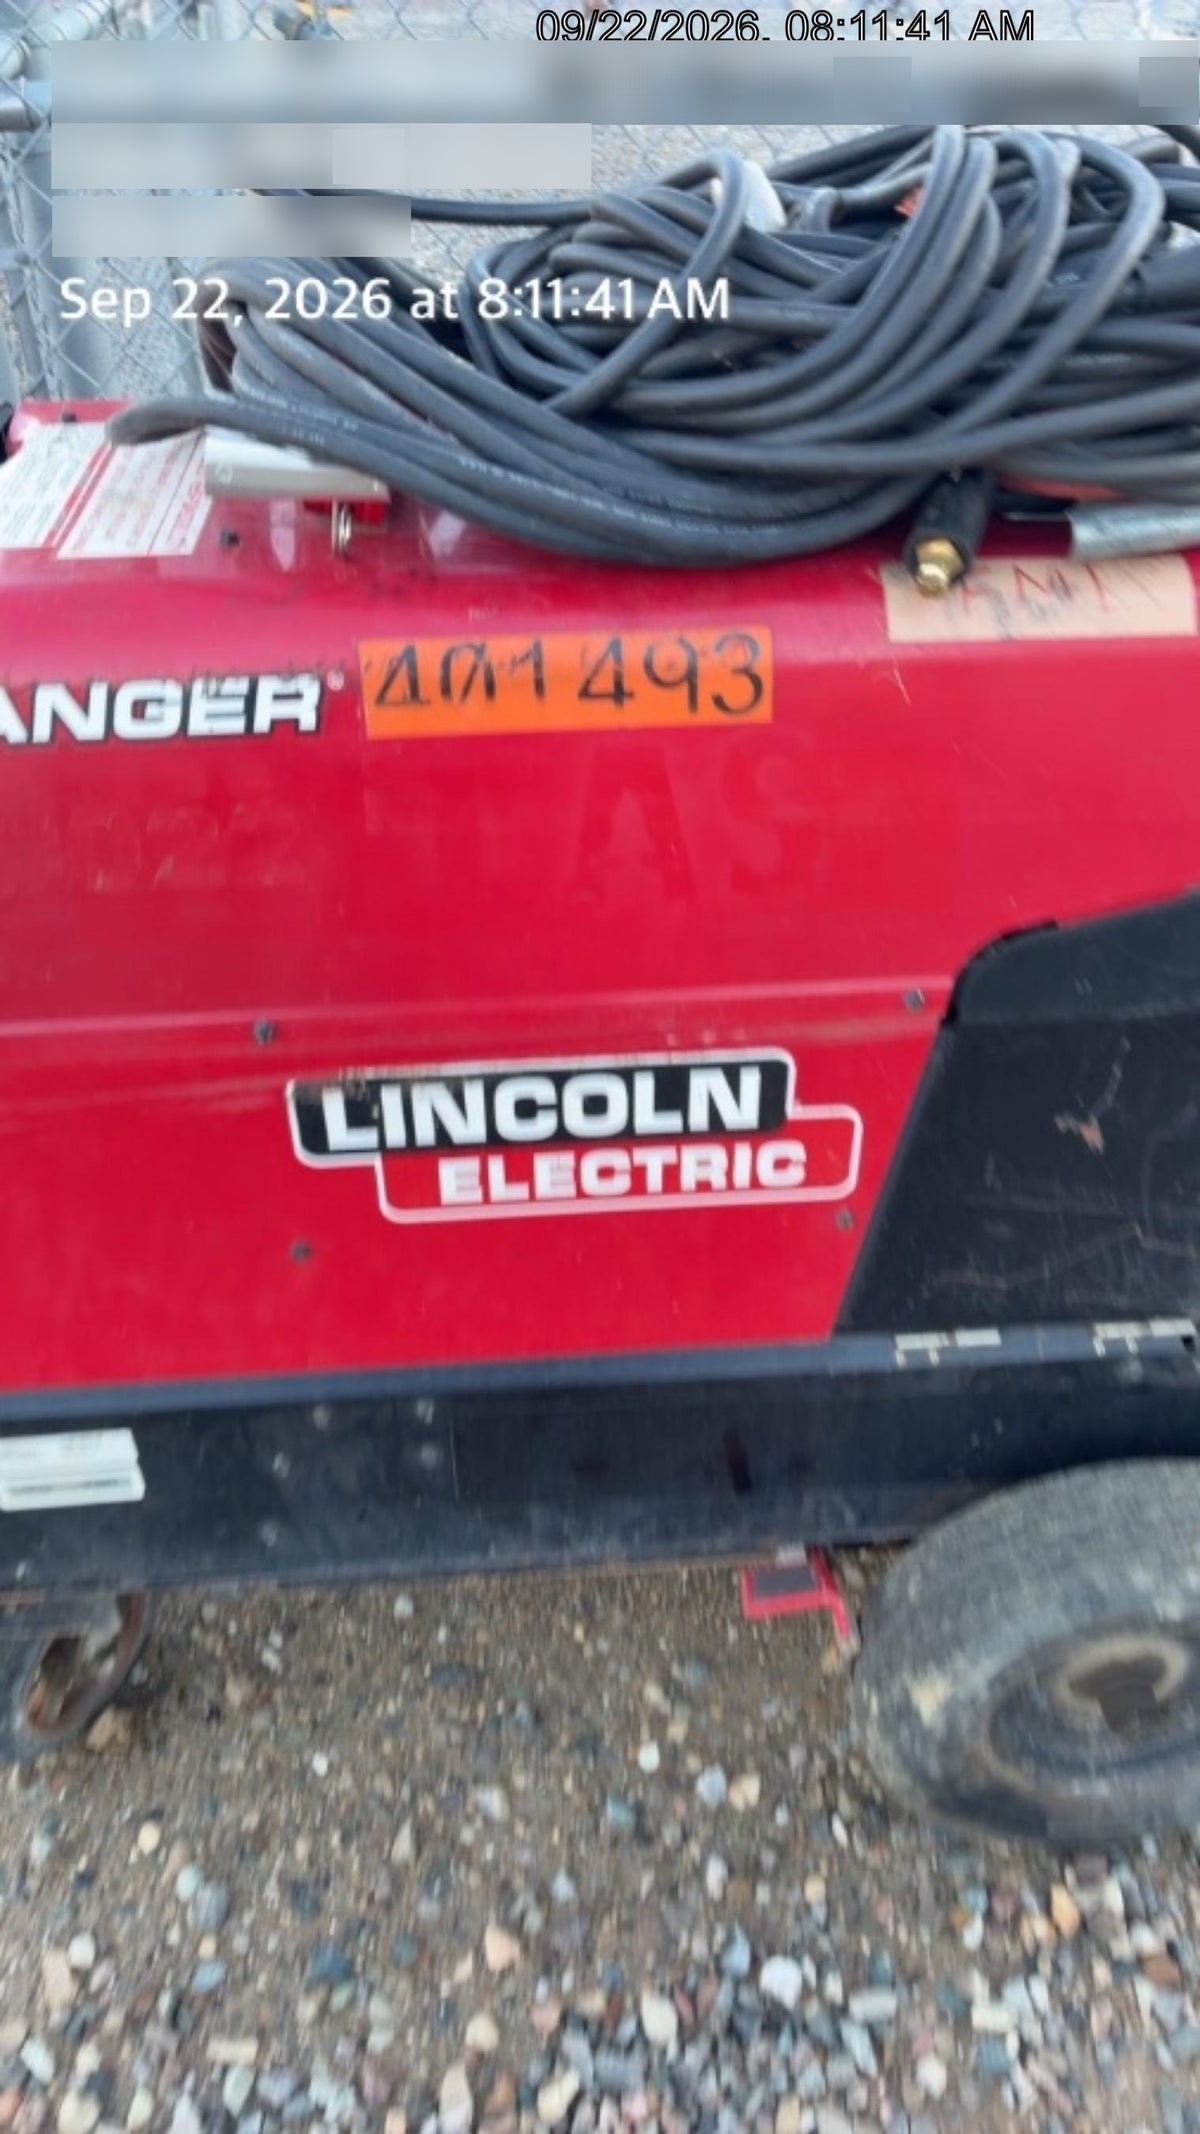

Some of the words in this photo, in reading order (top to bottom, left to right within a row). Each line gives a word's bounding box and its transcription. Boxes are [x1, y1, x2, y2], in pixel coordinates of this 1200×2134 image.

[577, 631, 765, 716] 493
[321, 1066, 761, 1152] LINCOLN
[437, 1139, 807, 1207] ELECTRIC
